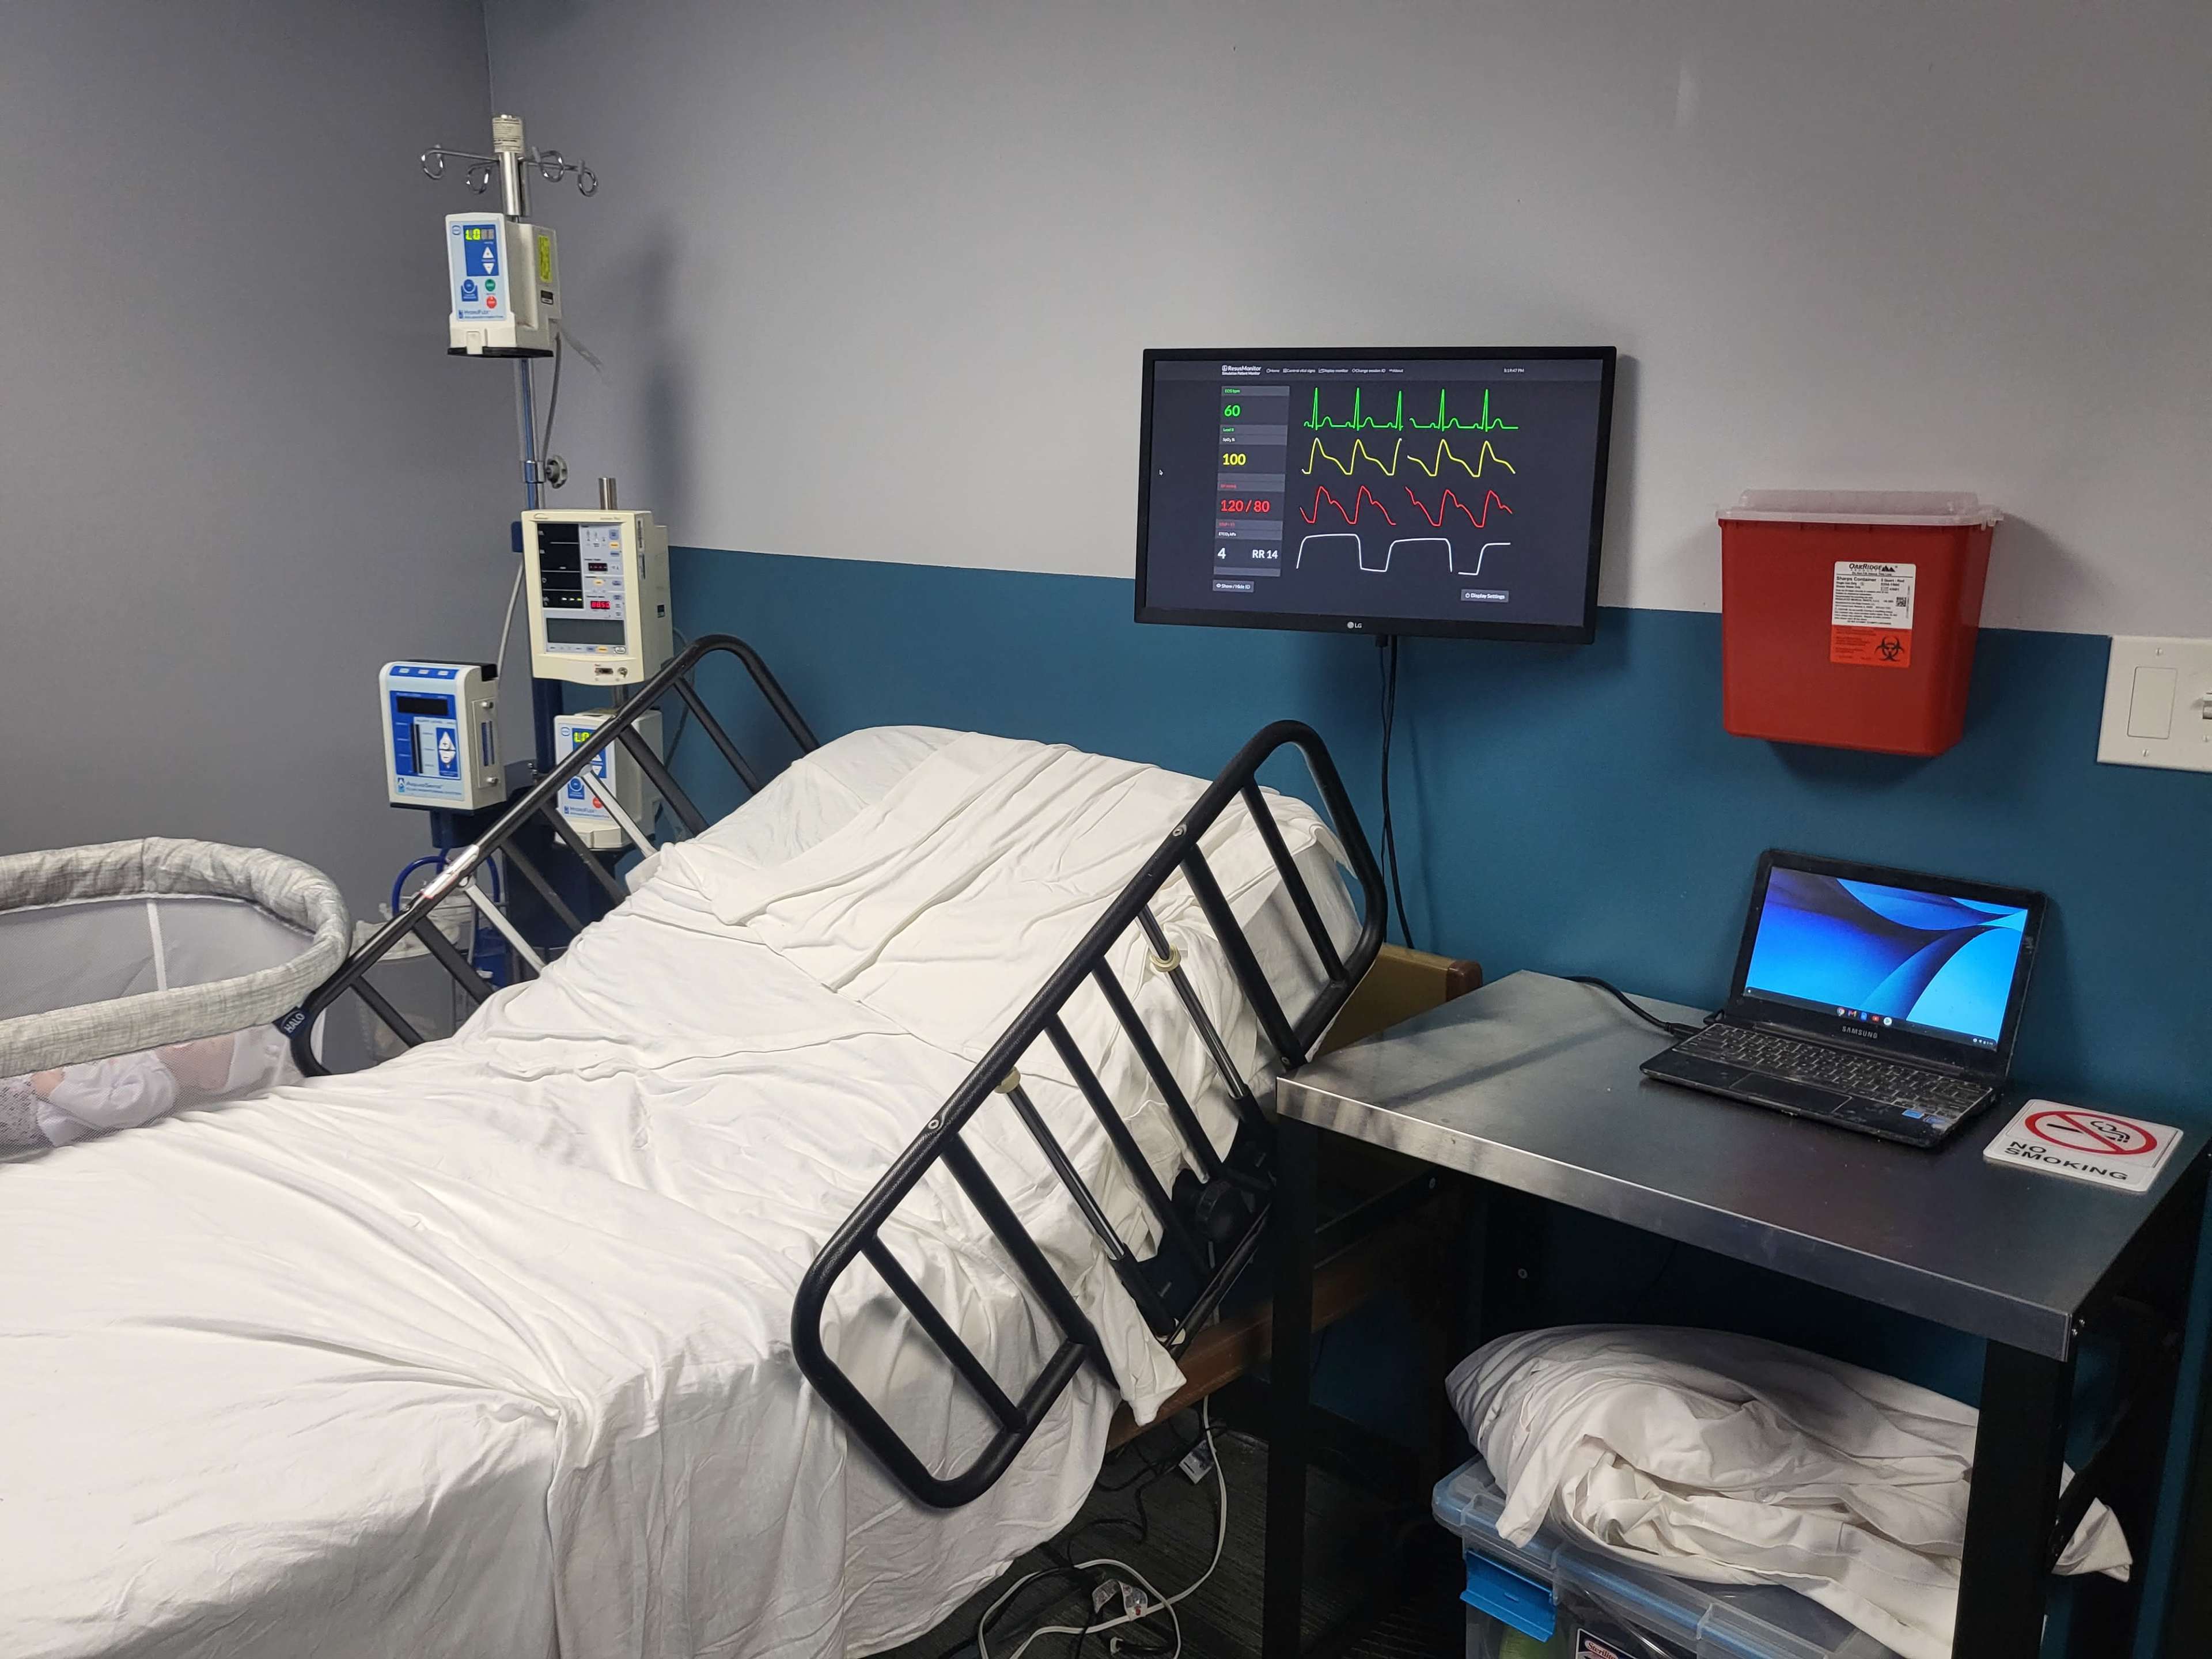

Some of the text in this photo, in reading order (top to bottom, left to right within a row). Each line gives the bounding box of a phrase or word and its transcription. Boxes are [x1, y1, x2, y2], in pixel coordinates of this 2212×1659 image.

[1224, 404, 1241, 417] 60
[1223, 453, 1246, 465] 100
[1221, 499, 1244, 512] 120
[1253, 501, 1270, 512] 80
[1217, 548, 1226, 559] 4
[1252, 550, 1278, 559] RR 14
[284, 1013, 305, 1033] HALO
[1842, 1026, 1878, 1039] SAMSUNG
[2010, 1141, 2046, 1153] NO
[2005, 1148, 2128, 1180] SMOKING
